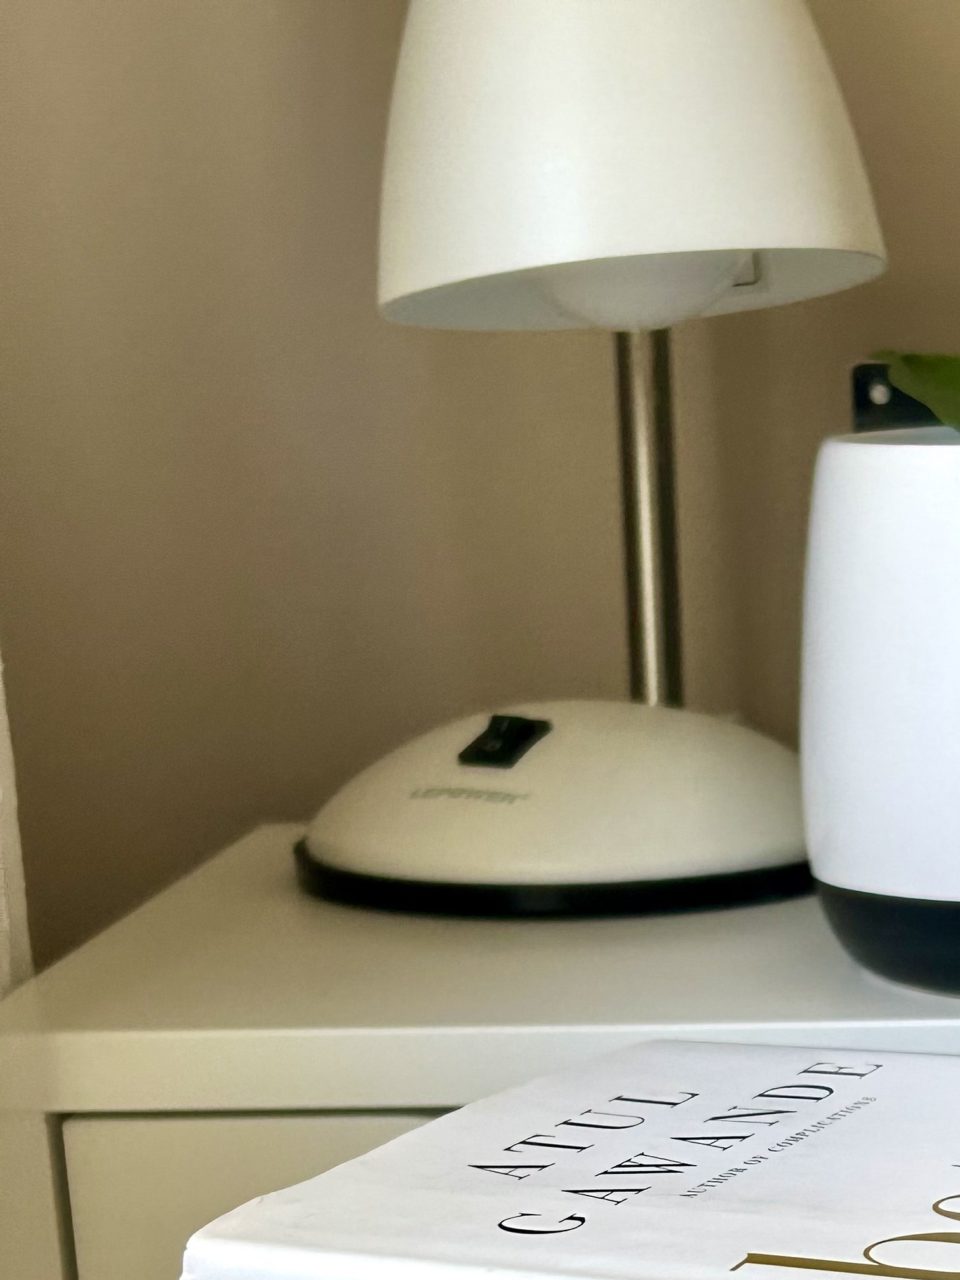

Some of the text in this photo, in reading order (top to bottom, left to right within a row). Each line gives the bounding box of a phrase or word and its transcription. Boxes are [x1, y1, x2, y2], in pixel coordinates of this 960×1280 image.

[468, 1090, 700, 1180] ATUL
[497, 1061, 884, 1235] GAWANDE
[680, 1096, 877, 1198] AUTHOR OF COMPLICATIONS
